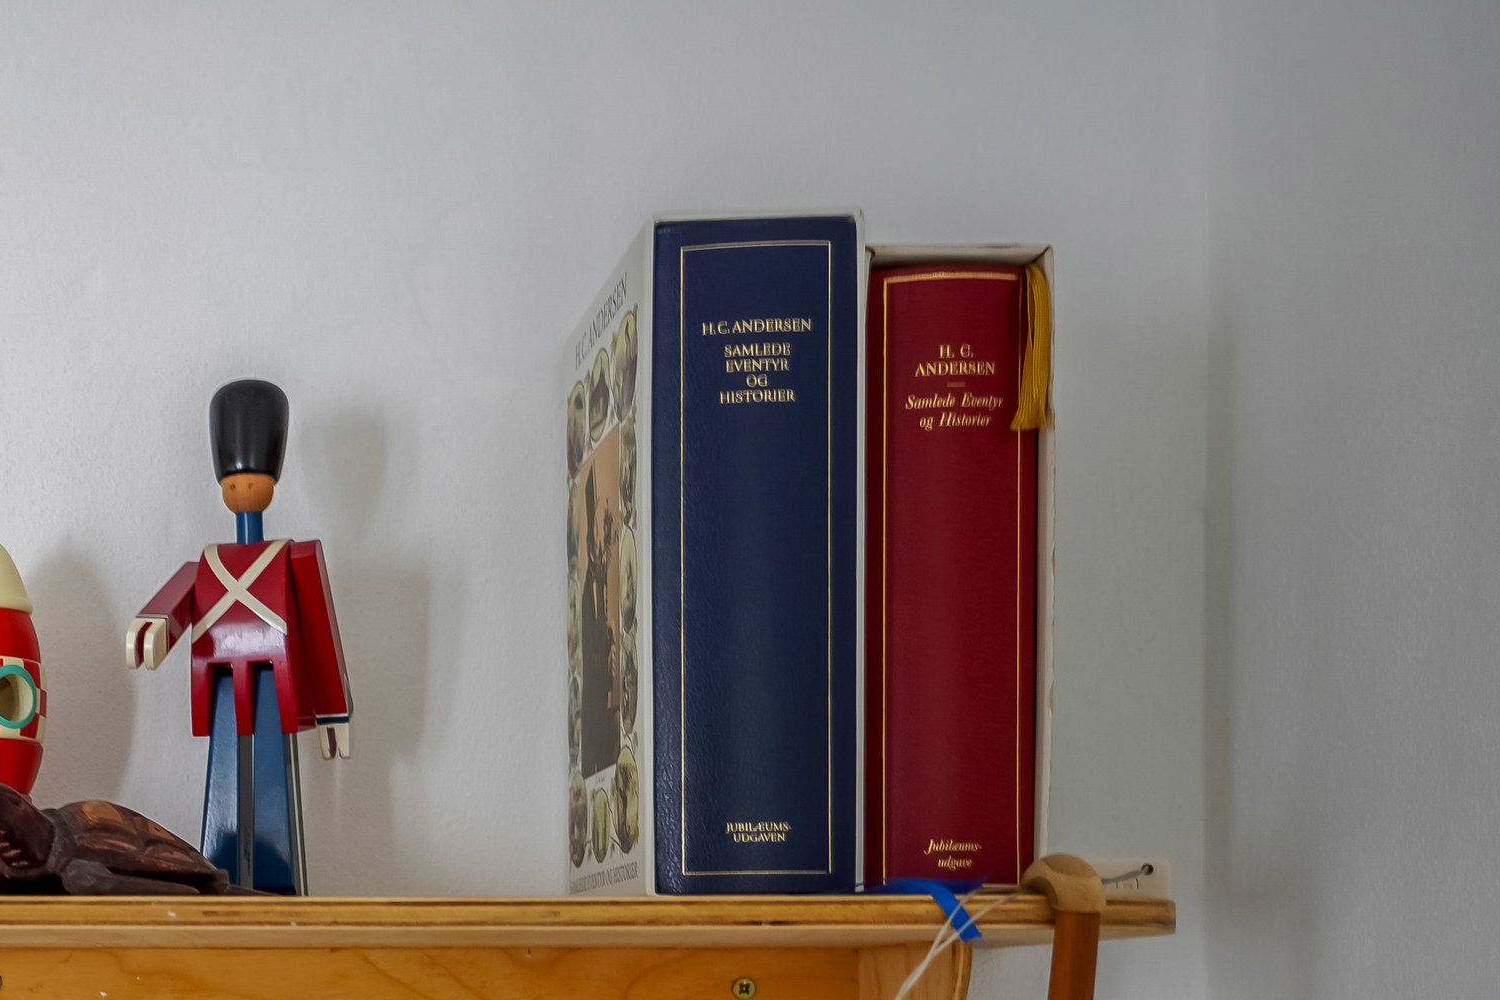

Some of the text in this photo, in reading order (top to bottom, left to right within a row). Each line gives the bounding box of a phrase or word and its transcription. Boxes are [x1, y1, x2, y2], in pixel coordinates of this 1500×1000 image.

[732, 318, 812, 334] ANDERSEN
[724, 342, 791, 358] SAMLEDE
[725, 358, 790, 373] EVENTYR
[915, 361, 996, 377] ANDERSEN
[746, 374, 768, 388] OG
[719, 388, 796, 405] HISTORIER
[905, 392, 1004, 411] Samlede Eventyr
[919, 411, 991, 431] og Historier
[733, 832, 786, 843] UDGAVEN
[937, 855, 973, 870] udgave
